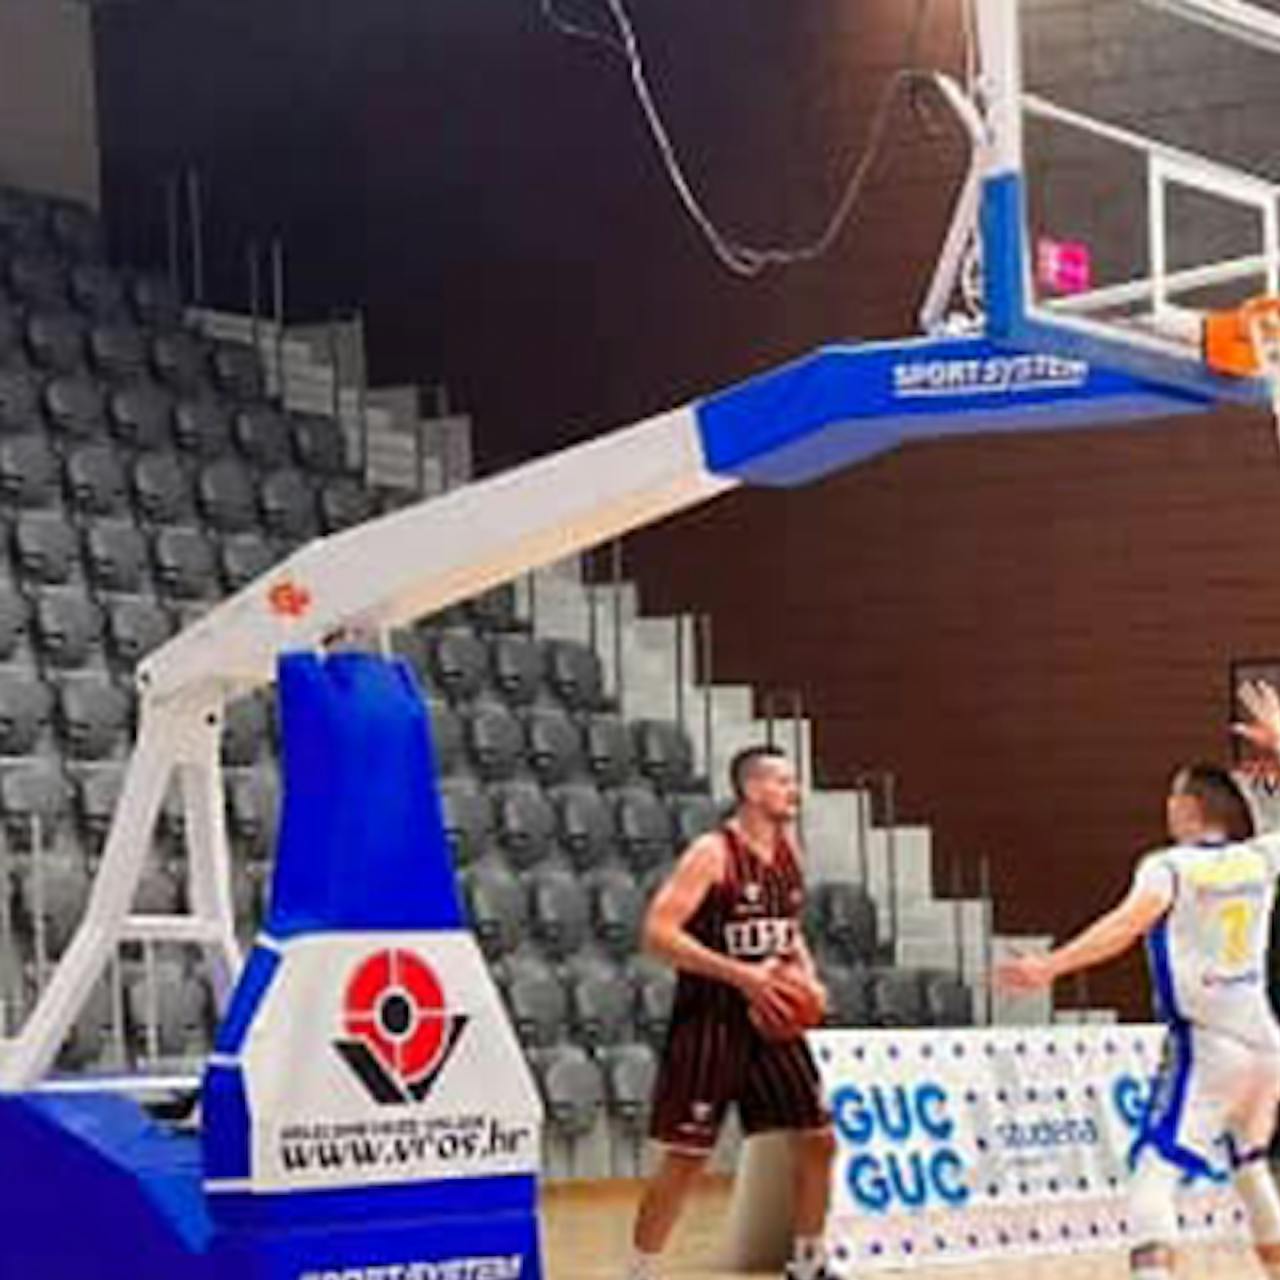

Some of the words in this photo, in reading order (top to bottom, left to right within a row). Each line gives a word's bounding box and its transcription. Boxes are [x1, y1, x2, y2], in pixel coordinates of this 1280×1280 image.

[831, 1084, 955, 1144] GUC
[281, 1118, 530, 1171] www.vros.hr
[846, 1148, 969, 1214] GUC
